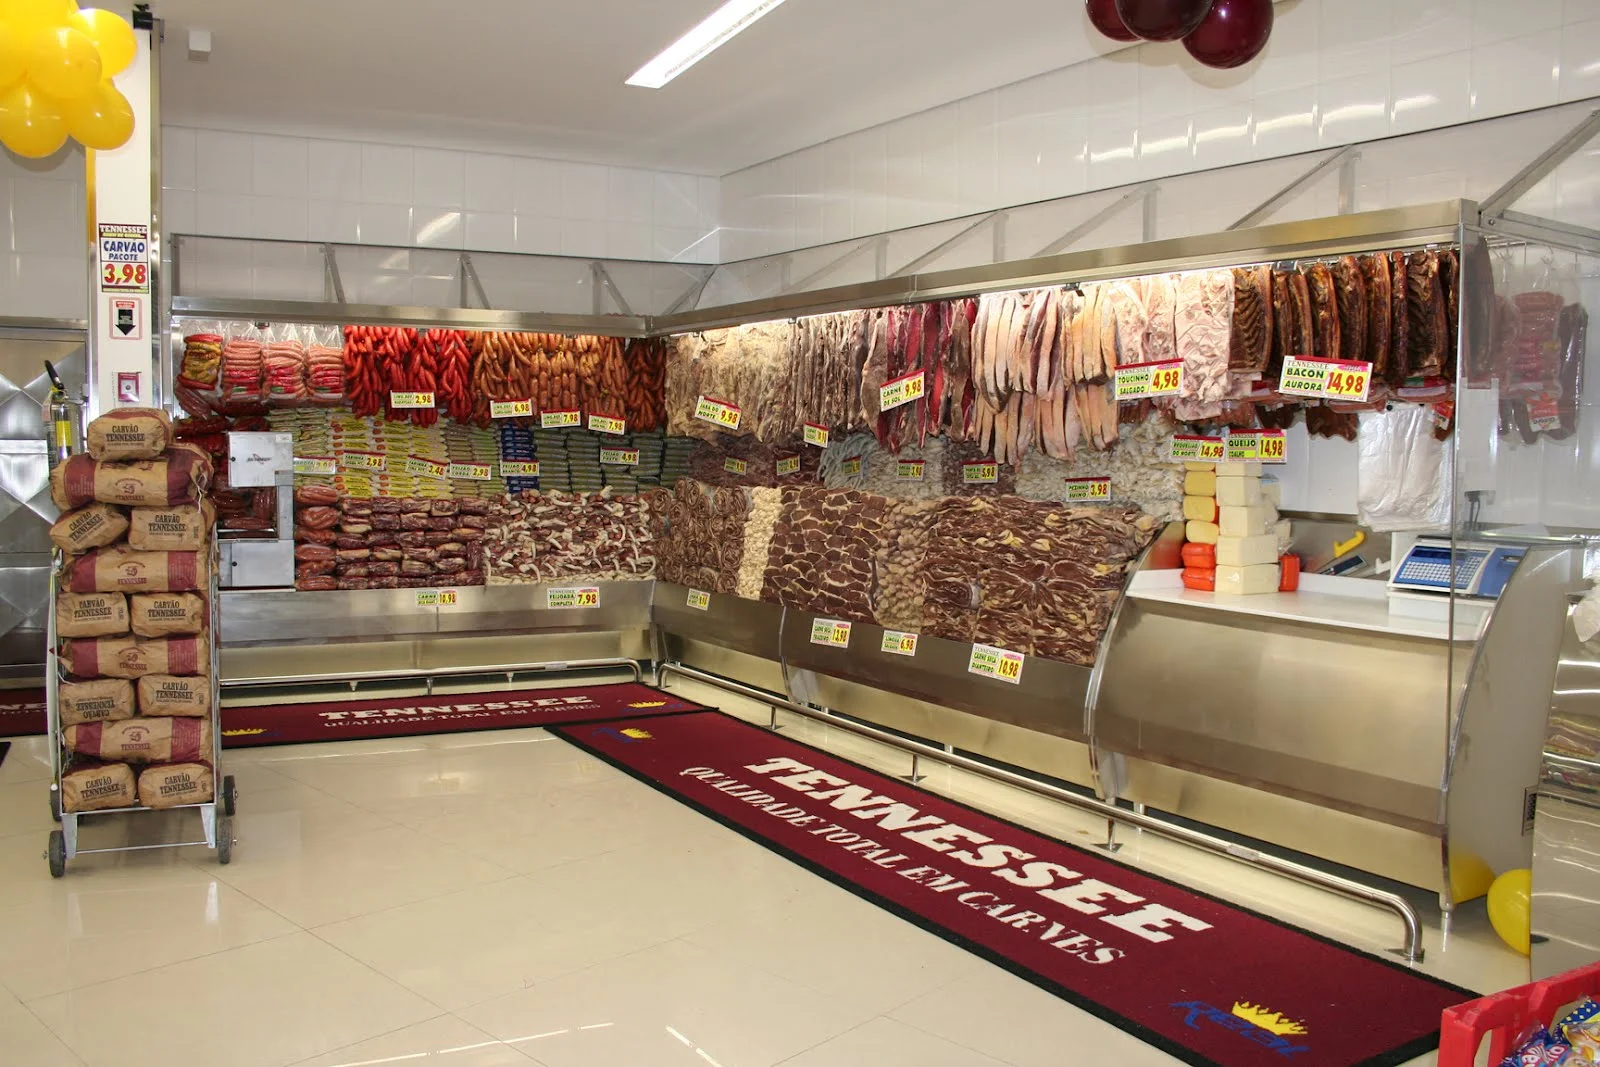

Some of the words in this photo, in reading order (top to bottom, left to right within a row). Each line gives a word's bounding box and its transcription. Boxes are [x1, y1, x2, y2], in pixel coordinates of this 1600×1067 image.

[100, 225, 147, 233] TENNESSEE
[109, 253, 138, 261] PACOTE
[104, 263, 146, 284] 3,98
[1287, 360, 1330, 369] TENNESSEE
[1118, 373, 1149, 384] TOUCINHO
[1286, 368, 1325, 379] BACON
[1152, 370, 1179, 390] 4,98
[1284, 380, 1323, 391] AURORA
[1326, 371, 1365, 394] 14,98
[882, 386, 902, 398] CARNE
[905, 379, 922, 397] 9,98
[1119, 385, 1145, 395] SALGADO
[415, 395, 432, 405] 2,98
[514, 403, 529, 413] 6,98
[563, 413, 578, 424] 7,98
[720, 410, 739, 424] 9,98
[112, 424, 138, 433] CARVÃO
[608, 421, 623, 431] 7,98
[106, 433, 145, 442] TENNESSEE
[1228, 439, 1256, 447] QUEIJO
[1200, 445, 1225, 458] 14,98
[1260, 439, 1284, 457] 14,98
[367, 457, 382, 467] 2,98
[472, 467, 489, 478] 2,98
[521, 464, 537, 473] 4,98
[1090, 484, 1107, 496] 3,98
[148, 523, 186, 532] TENNESSEE
[577, 594, 597, 605] 7,98
[74, 607, 112, 618] TENNESSEE
[147, 608, 186, 617] TENNESSEE
[900, 639, 914, 651] 6,98
[998, 659, 1019, 677] 10,98
[156, 690, 193, 699] TENNESSEE
[319, 696, 593, 720] TENNESSEE
[80, 783, 121, 799] TENNESSEE
[159, 781, 197, 795] TENNESSEE
[744, 757, 1214, 943] TENNESSEE
[678, 766, 821, 828] QUALIDADE
[808, 820, 898, 867] TOTAL
[896, 867, 968, 893] EM
[957, 890, 1126, 966] CARNES
